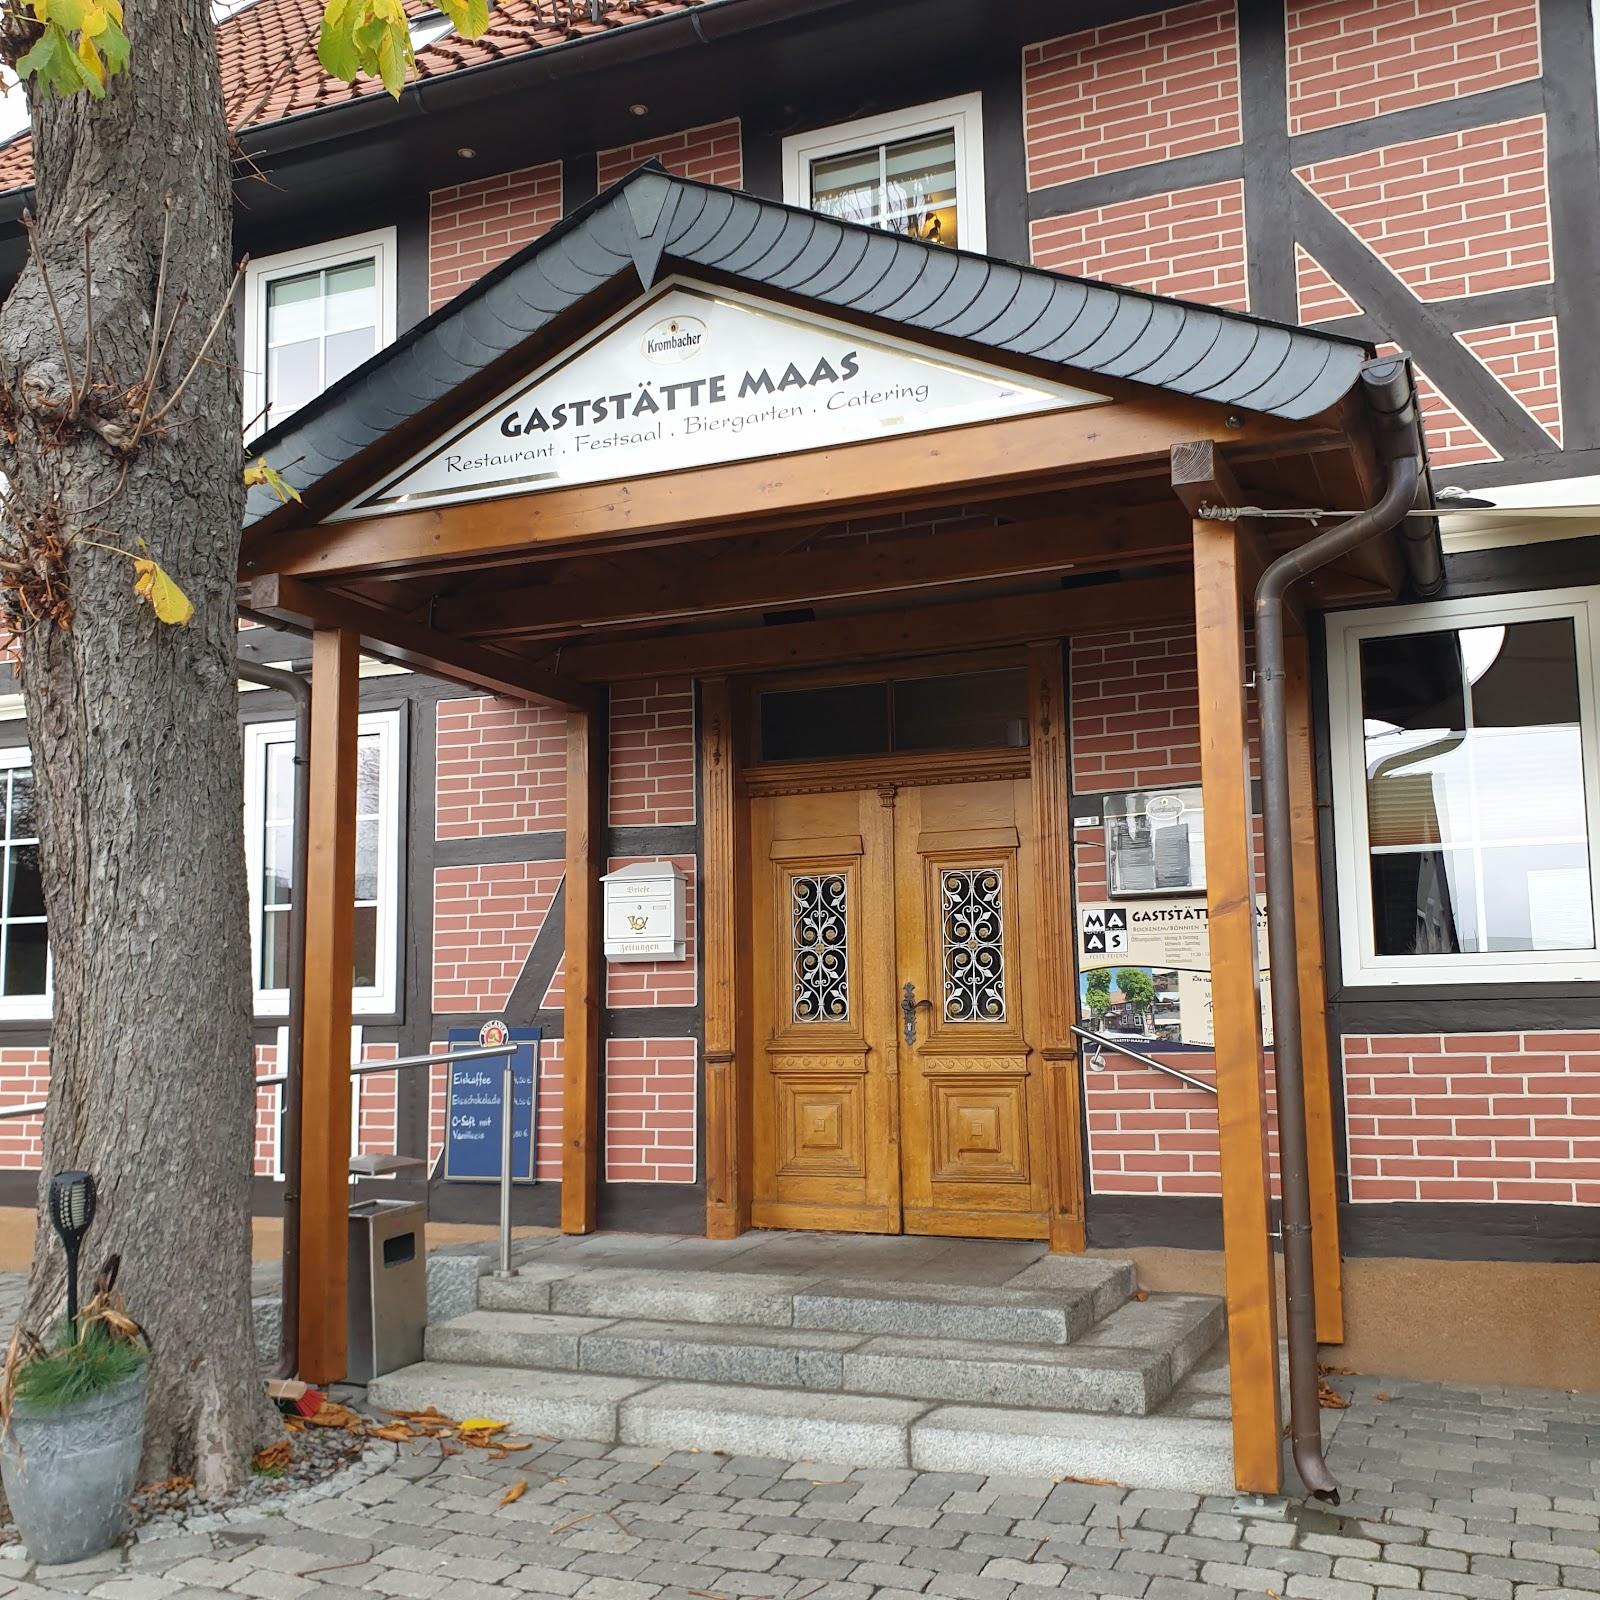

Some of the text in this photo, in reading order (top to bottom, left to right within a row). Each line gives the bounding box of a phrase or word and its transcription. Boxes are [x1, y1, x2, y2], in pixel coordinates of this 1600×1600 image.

[647, 332, 702, 354] Krombacher
[500, 351, 860, 438] GASTSTÄTTE MAAS
[445, 443, 554, 473] Restaurant
[574, 421, 661, 452] Festsaal
[683, 406, 803, 435] Biergarten
[826, 384, 929, 411] Catering
[1131, 905, 1209, 922] GASTSTÄTT
[620, 943, 660, 953] Zeitungen
[453, 1072, 492, 1087] Eiskaffee
